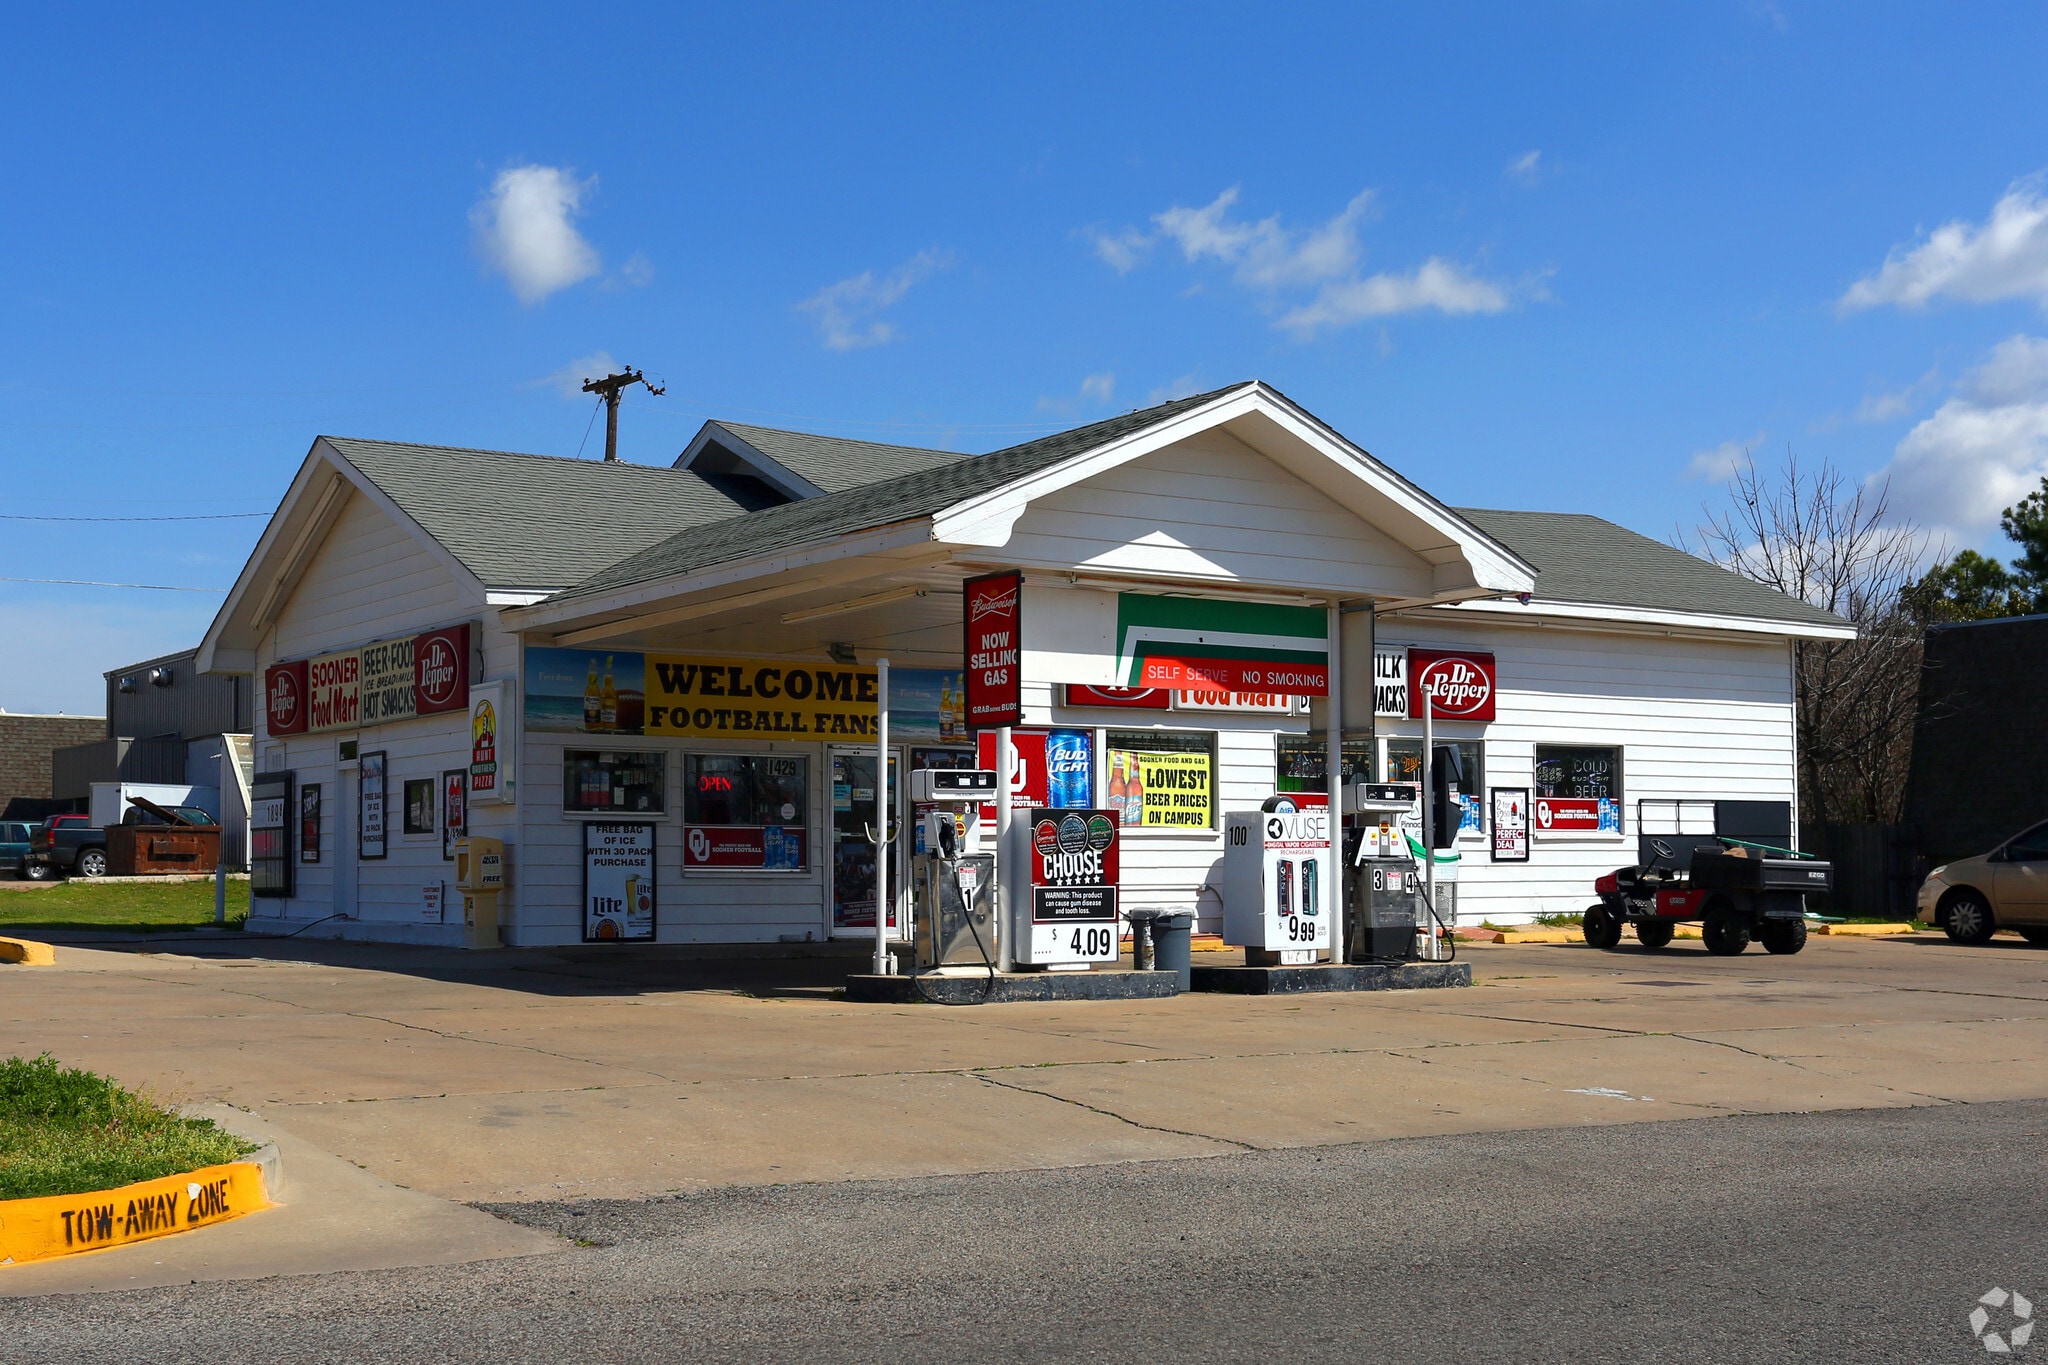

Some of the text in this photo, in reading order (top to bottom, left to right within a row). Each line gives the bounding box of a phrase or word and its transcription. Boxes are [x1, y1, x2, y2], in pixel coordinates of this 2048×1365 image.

[971, 596, 1017, 614] Budweiser
[982, 631, 1010, 650] NOW
[430, 645, 446, 668] Dr
[312, 657, 358, 688] SOONER
[420, 658, 454, 694] Pepper
[984, 669, 1008, 686] GAS
[1148, 665, 1228, 682] SELF SERVE
[1242, 671, 1324, 687] NO SMOKING
[1450, 664, 1476, 684] Dr
[278, 677, 288, 696] Dr
[656, 663, 878, 702] WELCOME
[1431, 673, 1487, 706] Pepper
[270, 688, 296, 720] Pepper
[312, 686, 358, 727] Food Mart
[364, 685, 416, 720] HOT SNACKS
[973, 705, 990, 714] GRAB
[650, 706, 878, 734] FOOTBALL FANS
[1054, 750, 1086, 760] BUD
[768, 759, 796, 776] 1429
[1050, 762, 1089, 772] LIGHT
[1574, 760, 1608, 772] COLD
[474, 775, 492, 788] PIZZA
[698, 776, 732, 792] OPEN
[1146, 768, 1207, 790] LOWEST
[1146, 793, 1208, 808] BEER PRICES
[1575, 785, 1608, 798] BEER
[1149, 811, 1203, 825] ON CAMPUS
[596, 826, 643, 834] FREE BAG
[1229, 826, 1247, 846] 100
[1282, 818, 1325, 839] VUSE
[1496, 830, 1525, 839] PERFECT
[1043, 850, 1104, 880] CHOOSE
[1375, 870, 1381, 889] 3
[1406, 874, 1413, 892] 4
[637, 884, 651, 896] Lite
[964, 888, 970, 908] 1
[1083, 892, 1103, 900] product
[592, 896, 622, 917] Lite
[1289, 916, 1315, 942] 9.99
[1052, 928, 1110, 956] $ 4.09
[61, 1178, 230, 1246] TOW-AWAY ZONE
